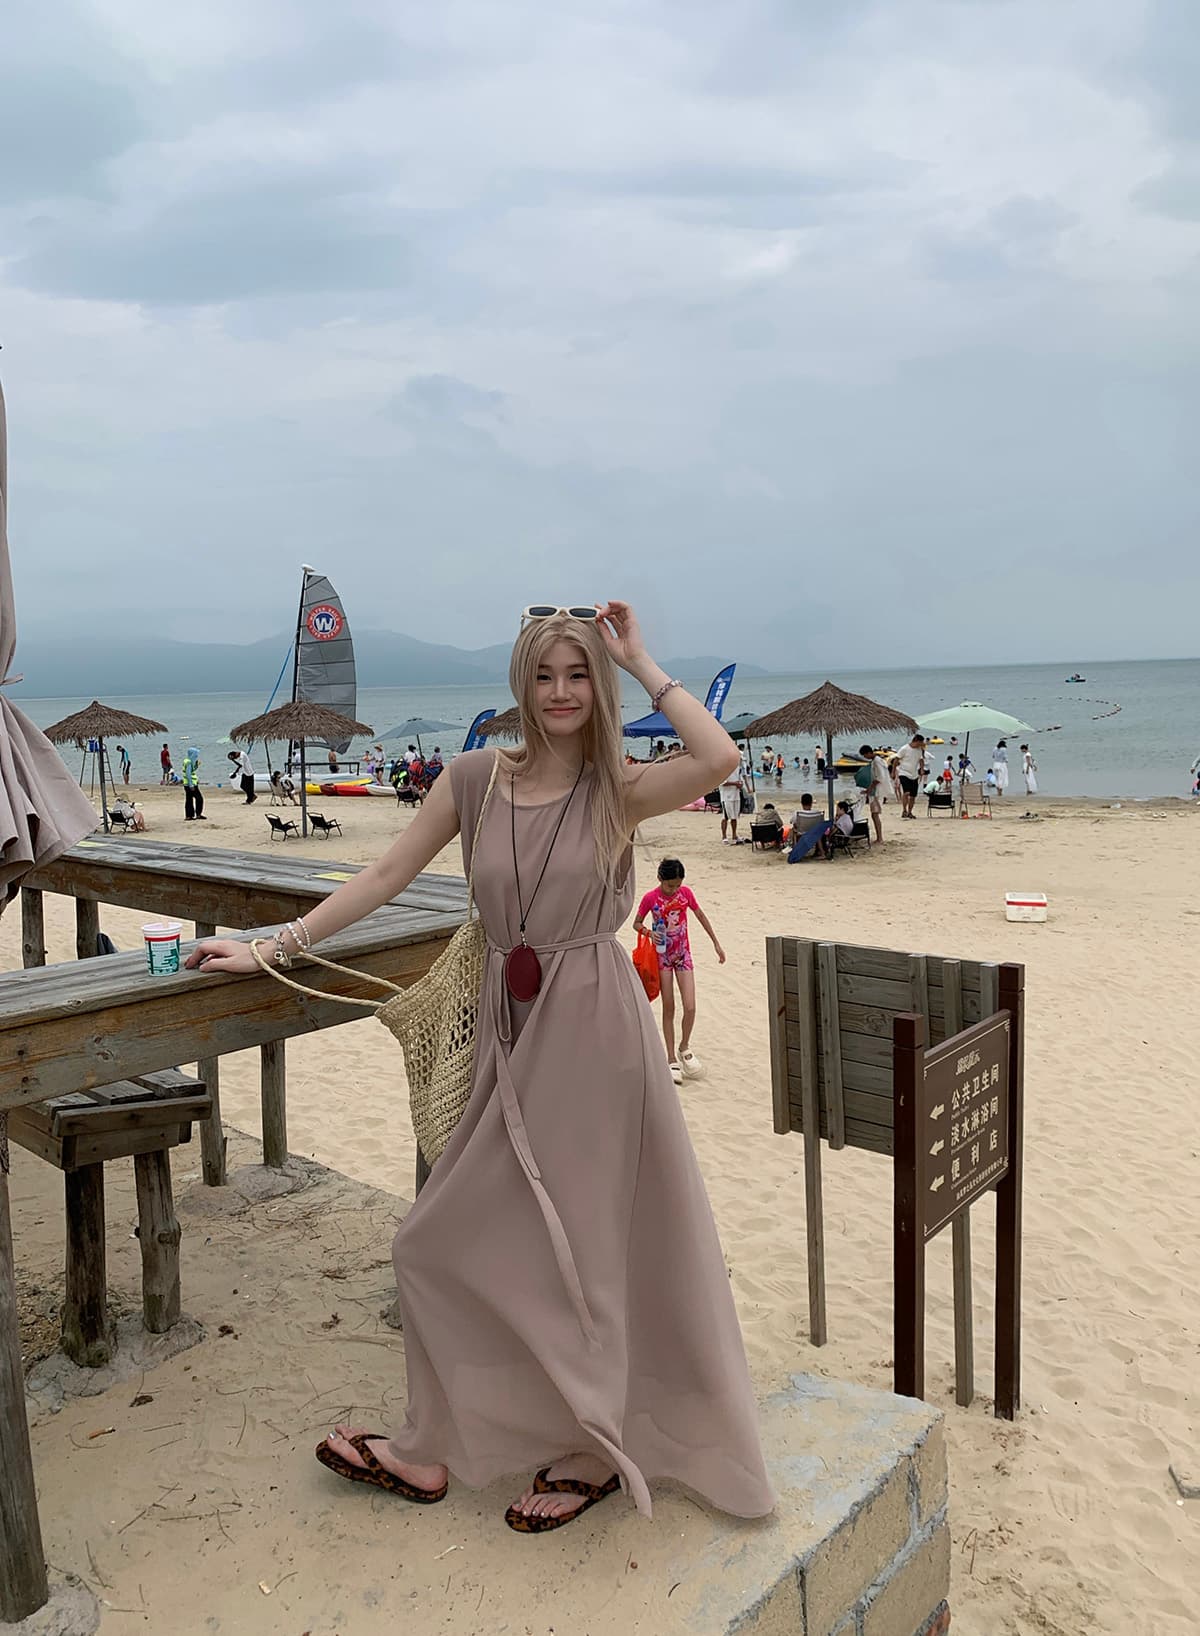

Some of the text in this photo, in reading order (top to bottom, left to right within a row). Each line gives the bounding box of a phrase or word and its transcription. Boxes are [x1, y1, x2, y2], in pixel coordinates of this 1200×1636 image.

[315, 617, 333, 631] W
[951, 1063, 999, 1110] 公共卫生间
[951, 1096, 999, 1147] 淡水淋浴间
[951, 1129, 998, 1182] 便利店
